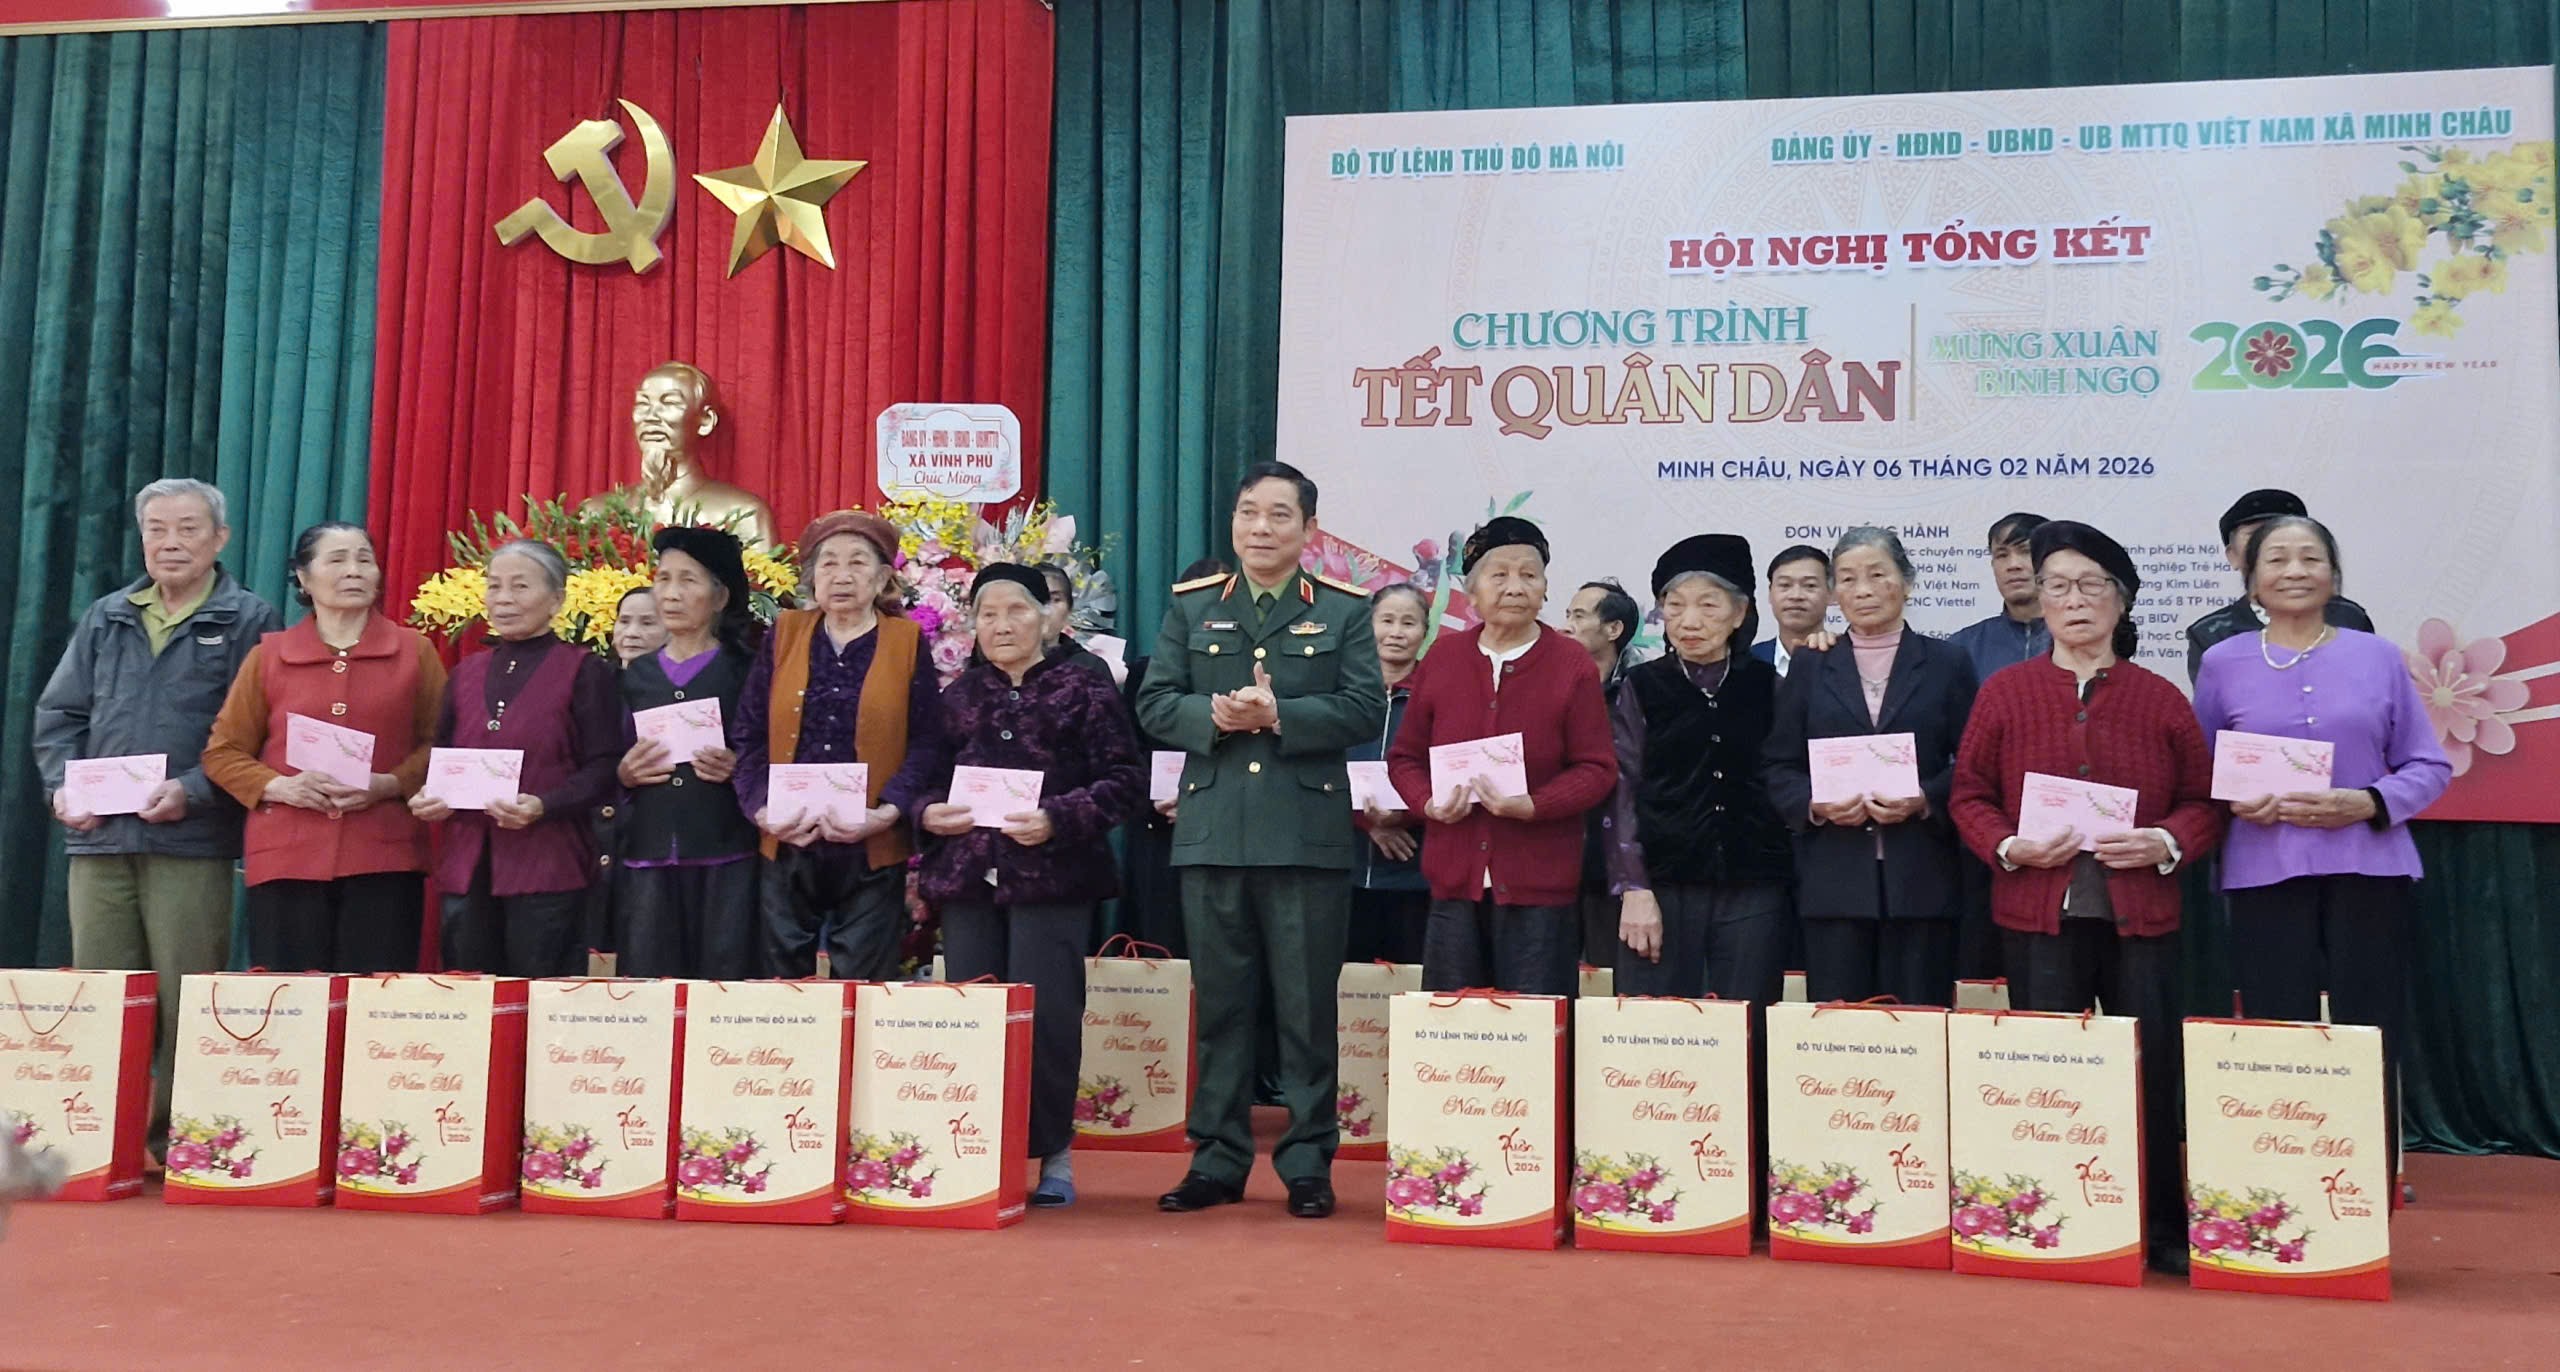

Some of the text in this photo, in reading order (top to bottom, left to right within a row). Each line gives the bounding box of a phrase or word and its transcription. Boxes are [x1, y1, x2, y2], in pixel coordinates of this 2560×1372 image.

[1771, 131, 1834, 161] ĐẢNG
[1842, 130, 1872, 159] ỦY
[1897, 131, 1962, 157] HĐND
[1988, 128, 2053, 153] UBND
[2080, 125, 2112, 150] UB
[2121, 122, 2189, 149] MTTQ
[2197, 116, 2250, 147] VIỆT
[2260, 117, 2315, 143] NAM
[2323, 112, 2355, 141] XÃ
[2365, 112, 2431, 139] MINH
[2441, 106, 2512, 136] CHÂU
[1332, 140, 1624, 178] BỘ TƯ LỆNH THỦ ĐÔ HÀ NỘI
[1669, 215, 2151, 274] HỘI NGHỊ TỔNG KẾT
[1453, 301, 1809, 348] CHƯƠNG TRÌNH
[1929, 325, 2158, 361] MỪNG XUÂN
[2188, 318, 2402, 390] 2026
[1977, 362, 2161, 400] BÍNH NGỌ
[1353, 346, 1902, 439] TẾT QUÂN DÂN
[909, 451, 926, 467] XÃ
[931, 451, 962, 467] VĨNH
[1658, 455, 2155, 481] MINH CHÂU, NGÀY 06 THÁNG 02 NĂM 2026
[914, 470, 982, 485] Chúc Mừng
[1785, 525, 1821, 538] ĐƠN
[1903, 522, 1950, 538] HÀNH
[1919, 546, 1964, 558] chuyên
[2150, 543, 2174, 557] phố
[2178, 545, 2195, 554] Hà
[2199, 544, 2220, 556] Nội
[2142, 562, 2187, 574] nghiệp
[1923, 580, 1980, 592] Việt Nam
[2166, 579, 2190, 589] Kim
[2194, 579, 2220, 589] Liên
[1936, 596, 1975, 607] Viettel
[2158, 595, 2172, 606] số
[2187, 596, 2203, 606] TP
[2148, 613, 2179, 624] BIDV
[2147, 631, 2172, 643] học
[2158, 647, 2183, 659] Văn
[799, 1140, 822, 1149] 2026
[962, 1146, 986, 1154] 2026
[1515, 1163, 1540, 1171] 2026
[1708, 1168, 1734, 1177] 2026
[1908, 1179, 1934, 1188] 2026
[2094, 1193, 2123, 1203] 2026
[2341, 1206, 2371, 1216] 2026
